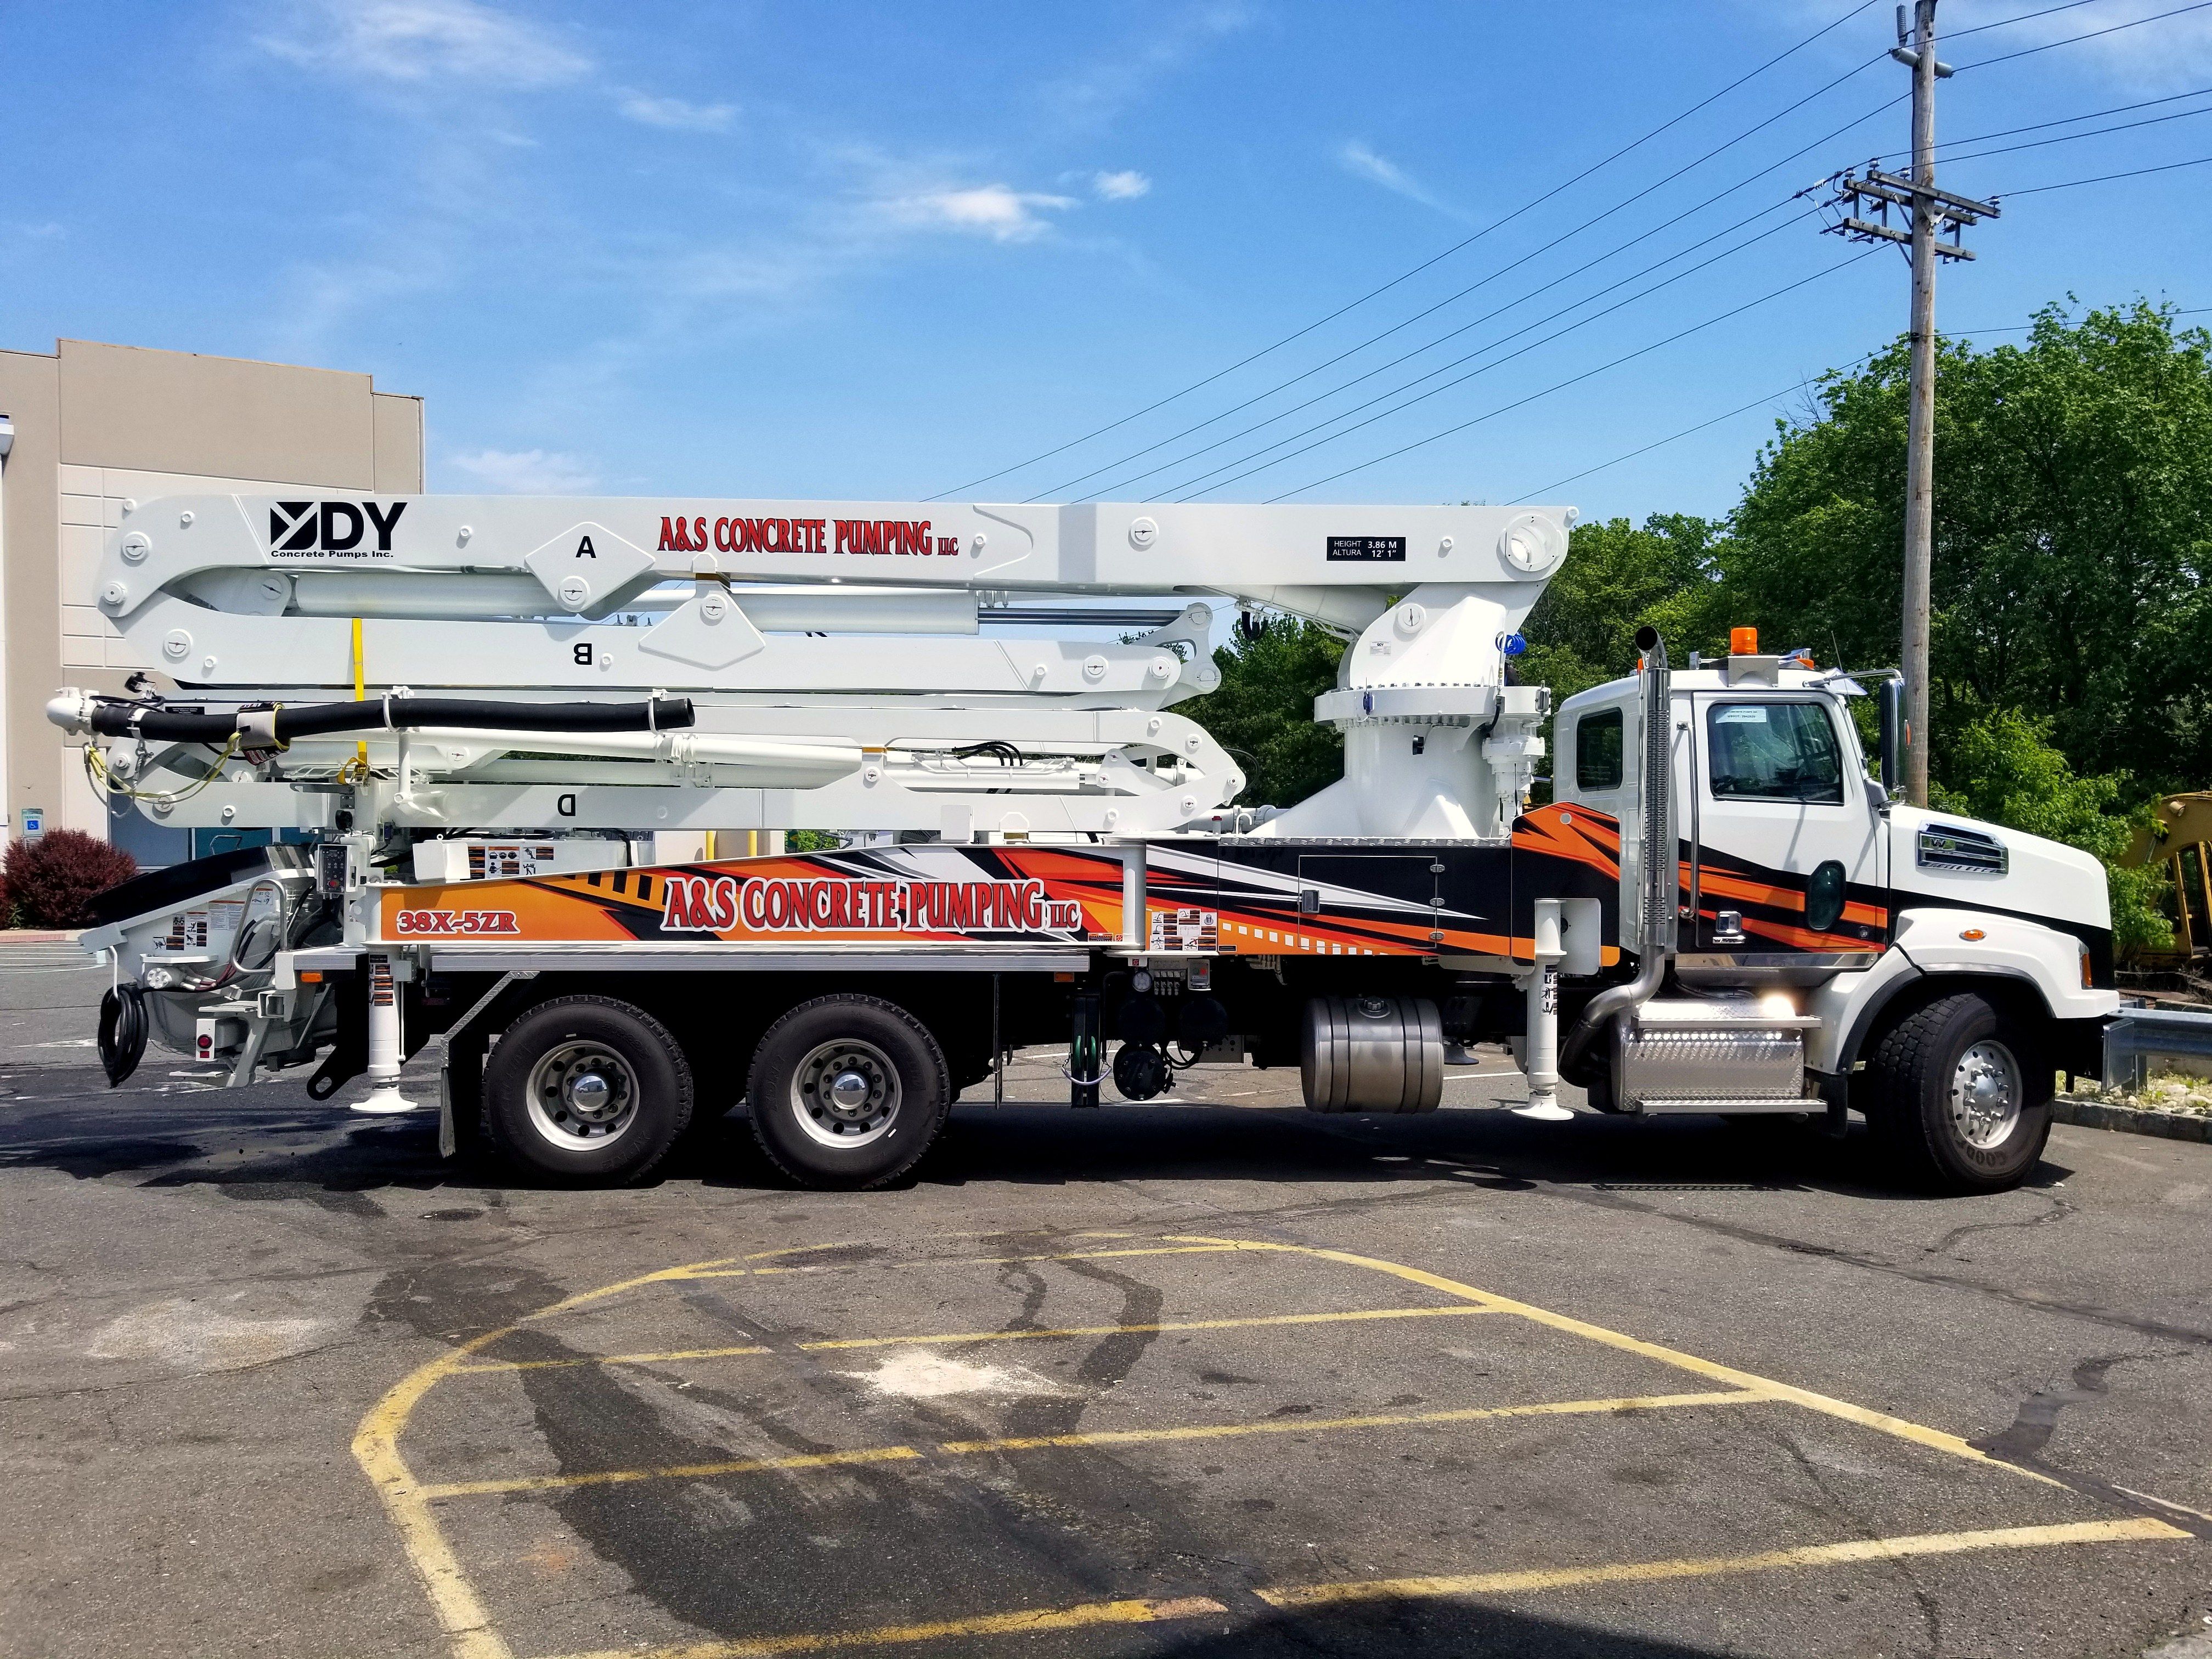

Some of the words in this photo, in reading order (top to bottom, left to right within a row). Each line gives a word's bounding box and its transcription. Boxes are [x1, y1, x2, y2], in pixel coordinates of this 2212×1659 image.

[321, 501, 408, 550] DY
[657, 517, 708, 551] A&S
[714, 518, 827, 554] CONCRETE
[833, 520, 932, 556] PUMPING
[937, 537, 959, 556] LLC
[575, 536, 596, 558] A
[573, 643, 592, 665] B
[558, 794, 576, 816] D
[665, 881, 736, 929] A&S
[744, 881, 899, 930] CONCRETE
[907, 882, 1042, 932] PUMPING
[1049, 904, 1077, 928] LLC
[397, 911, 520, 934] 38X-5ZR
